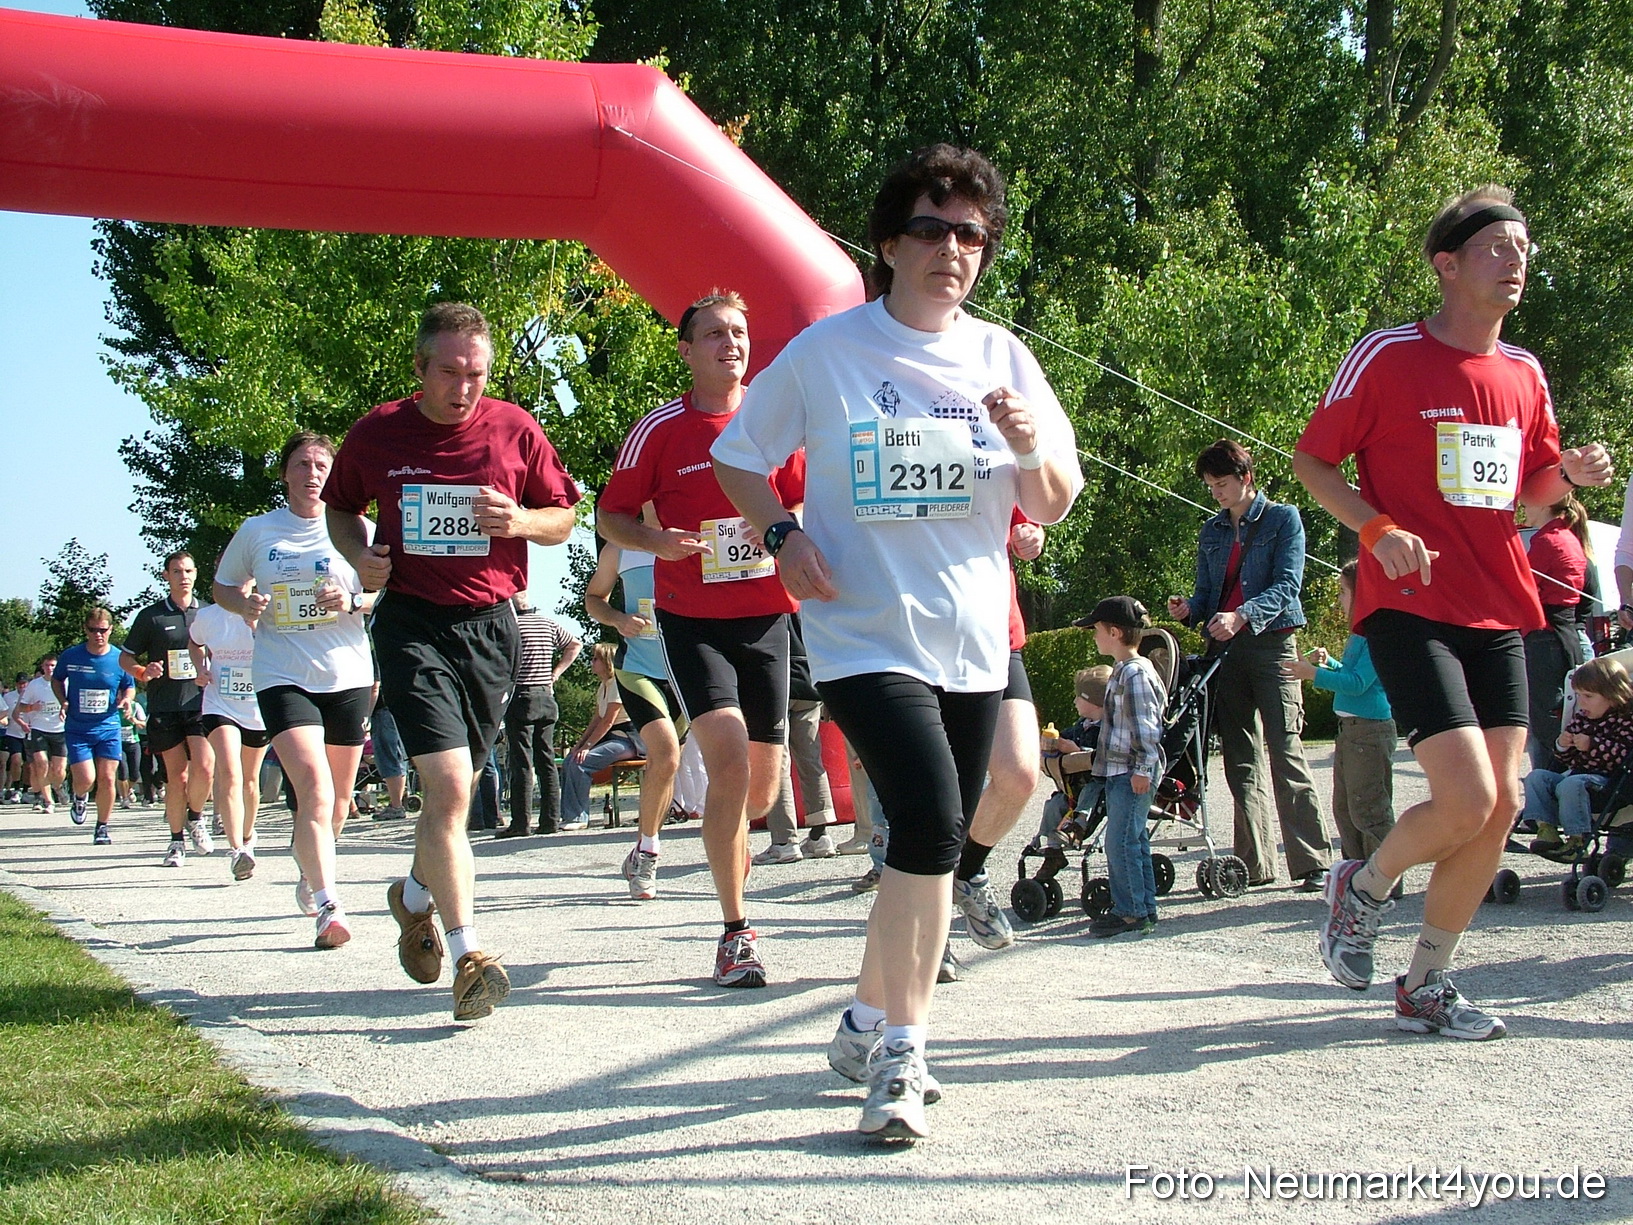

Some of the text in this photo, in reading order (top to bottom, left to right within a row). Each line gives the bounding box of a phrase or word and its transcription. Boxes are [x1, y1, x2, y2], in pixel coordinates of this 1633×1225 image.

[1420, 407, 1464, 419] TOSHIBA
[885, 428, 921, 447] Betti
[1463, 431, 1496, 448] Patrik
[856, 459, 864, 474] D
[1441, 454, 1448, 466] C
[677, 461, 712, 476] TOSHIBA
[1473, 461, 1508, 485] 923
[889, 463, 965, 491] 2312
[427, 491, 472, 508] Wolfgan
[856, 504, 901, 516] BOCK
[929, 503, 970, 512] PFLEIDERER
[406, 512, 412, 523] C
[428, 516, 482, 536] 2884
[718, 524, 736, 538] Sigi
[728, 544, 763, 562] 924
[87, 699, 107, 707] 2229
